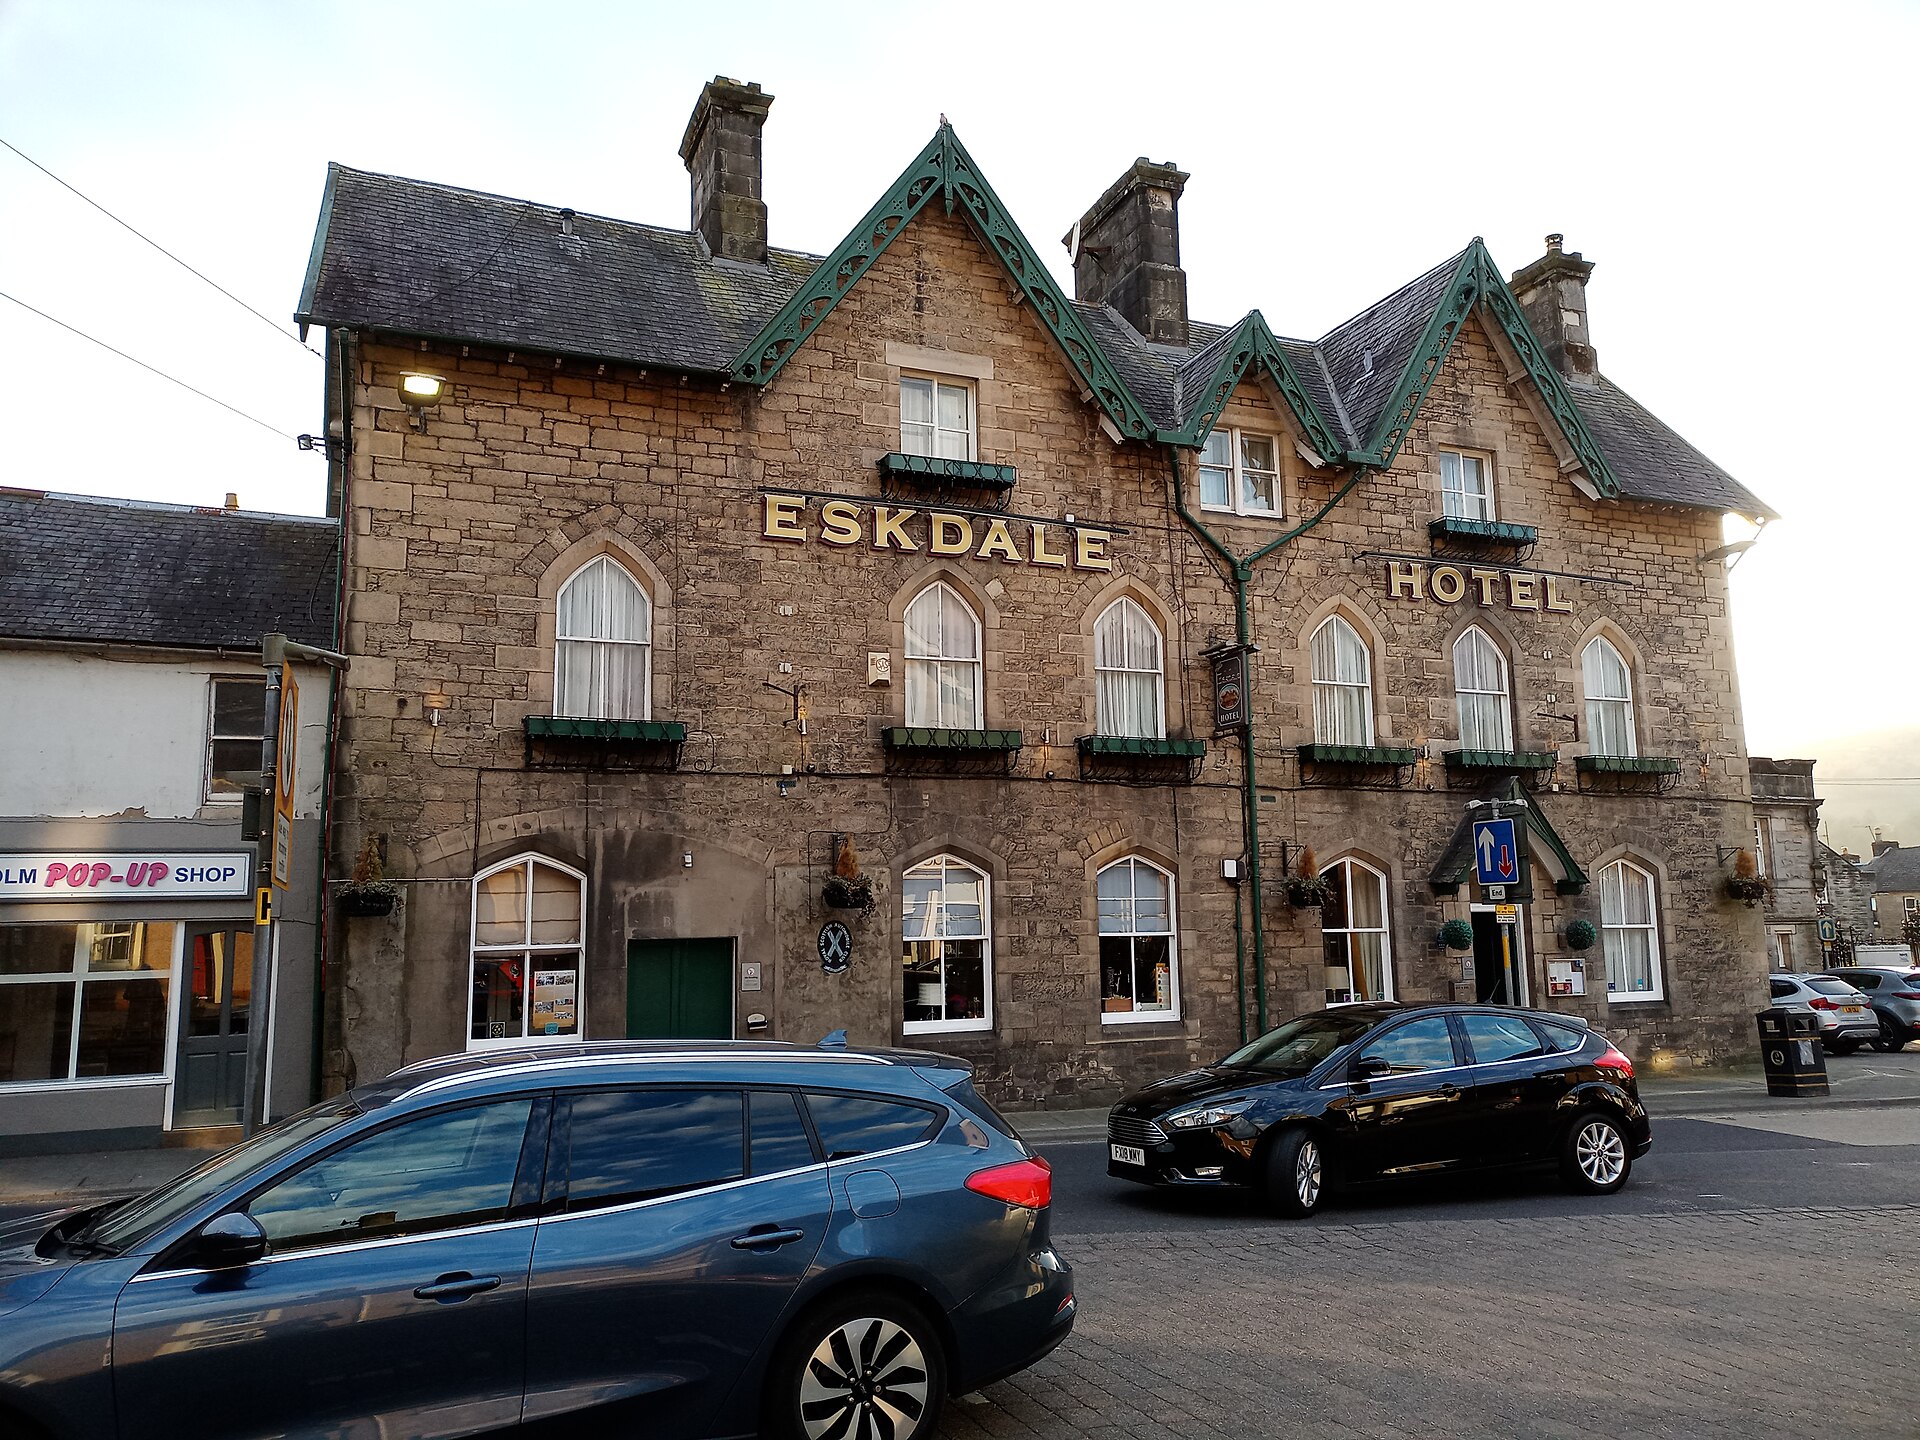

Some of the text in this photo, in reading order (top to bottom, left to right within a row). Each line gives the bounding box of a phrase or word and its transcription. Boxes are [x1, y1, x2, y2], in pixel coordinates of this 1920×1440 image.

[761, 493, 1113, 573] ESKDALE
[1386, 561, 1574, 614] HOTEL
[1220, 711, 1239, 722] HOTEL
[44, 862, 169, 887] POP-UP
[174, 867, 236, 882] SHOP
[1491, 889, 1503, 897] End
[819, 922, 850, 963] ROYAL SCOTTISH AUTOMOBILE CLUB
